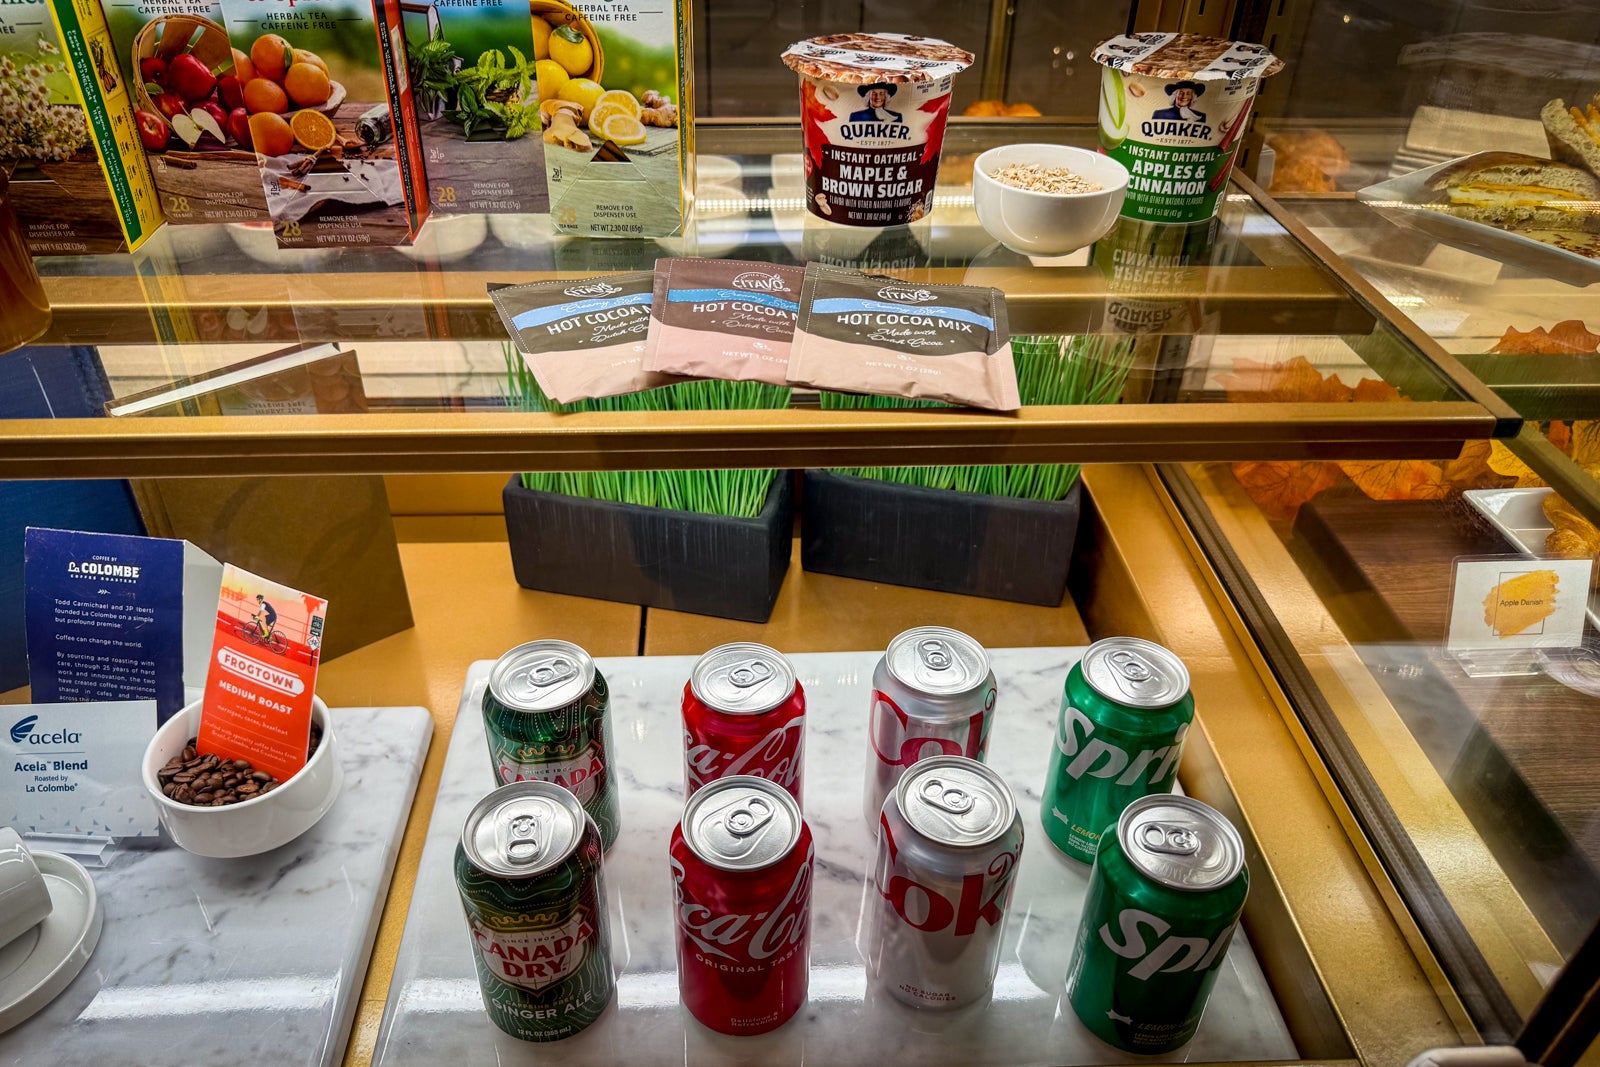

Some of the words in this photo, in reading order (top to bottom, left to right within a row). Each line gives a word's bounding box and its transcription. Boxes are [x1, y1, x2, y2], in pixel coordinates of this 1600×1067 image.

[138, 6, 184, 14] CAFFEINE
[187, 5, 211, 13] FREE
[572, 4, 608, 12] HERBAL
[266, 12, 305, 20] HERBAL
[565, 14, 611, 22] CAFFEINE
[614, 13, 637, 21] FREE
[261, 22, 309, 30] CAFFEINE
[840, 123, 911, 140] QUAKER
[1141, 121, 1211, 141] QUAKER
[831, 149, 871, 165] INSTANT
[874, 151, 918, 165] OATMEAL
[1128, 145, 1170, 161] INSTANT
[1172, 152, 1215, 162] OATMEAL
[839, 165, 893, 182] MAPLE
[897, 166, 908, 181] &
[1132, 160, 1191, 180] APPLES
[1195, 165, 1206, 178] &
[822, 176, 874, 198] BROWN
[878, 179, 923, 198] SUGAR
[1128, 177, 1207, 196] CINNAMON
[437, 186, 456, 202] 28
[1136, 194, 1149, 203] WITH
[1149, 195, 1165, 204] OTHER
[1165, 197, 1185, 206] NATURAL
[169, 197, 190, 213] 28
[873, 200, 893, 209] NATURAL
[894, 197, 912, 207] FLAVORS
[558, 207, 577, 224] 28
[280, 221, 301, 237] 28
[732, 277, 785, 290] CITAVO
[717, 290, 766, 303] Creamy
[693, 302, 731, 314] HOT
[731, 302, 788, 319] COCOA
[861, 301, 910, 314] Creamy
[546, 319, 582, 336] HOT
[585, 305, 643, 325] COCOA
[729, 312, 767, 322] Made
[837, 313, 873, 326] HOT
[876, 314, 934, 327] COCOA
[938, 318, 973, 334] MIX
[592, 322, 628, 336] Made
[629, 316, 649, 325] with
[722, 320, 761, 329] Dutch
[872, 328, 913, 337] Made
[907, 337, 944, 348] Cocoa
[68, 561, 80, 573] La
[81, 562, 140, 579] COLOMBE
[55, 598, 70, 606] Todd
[72, 600, 109, 610] Carmichael
[111, 603, 123, 611] and
[1500, 599, 1519, 608] Apple
[55, 608, 80, 616] founded
[90, 610, 118, 619] Colombe
[133, 615, 154, 623] simple
[67, 618, 95, 627] profound
[96, 621, 123, 629] premise:
[55, 634, 75, 642] Coffee
[89, 637, 112, 647] change
[67, 653, 95, 662] sourcing
[111, 657, 139, 666] roasting
[74, 662, 101, 671] through
[112, 666, 130, 674] years
[224, 653, 294, 689] FROGTOWN
[91, 672, 128, 682] innovation,
[58, 686, 79, 694] shared
[74, 679, 97, 687] created
[99, 681, 118, 689] coffee
[120, 684, 156, 693] experiences
[219, 679, 257, 701] MEDIUM
[258, 695, 293, 715] ROAST
[28, 728, 82, 745] acela
[53, 760, 88, 771] Blend
[61, 775, 68, 783] by
[26, 784, 35, 793] La
[474, 920, 594, 962] CANADA
[695, 953, 765, 973] ORIGINAL
[899, 984, 911, 993] NO
[913, 991, 956, 1001] CALORIES
[906, 984, 918, 992] NO
[492, 998, 558, 1019] GINGER
[564, 990, 593, 1014] ALE
[559, 1025, 572, 1034] mL)
